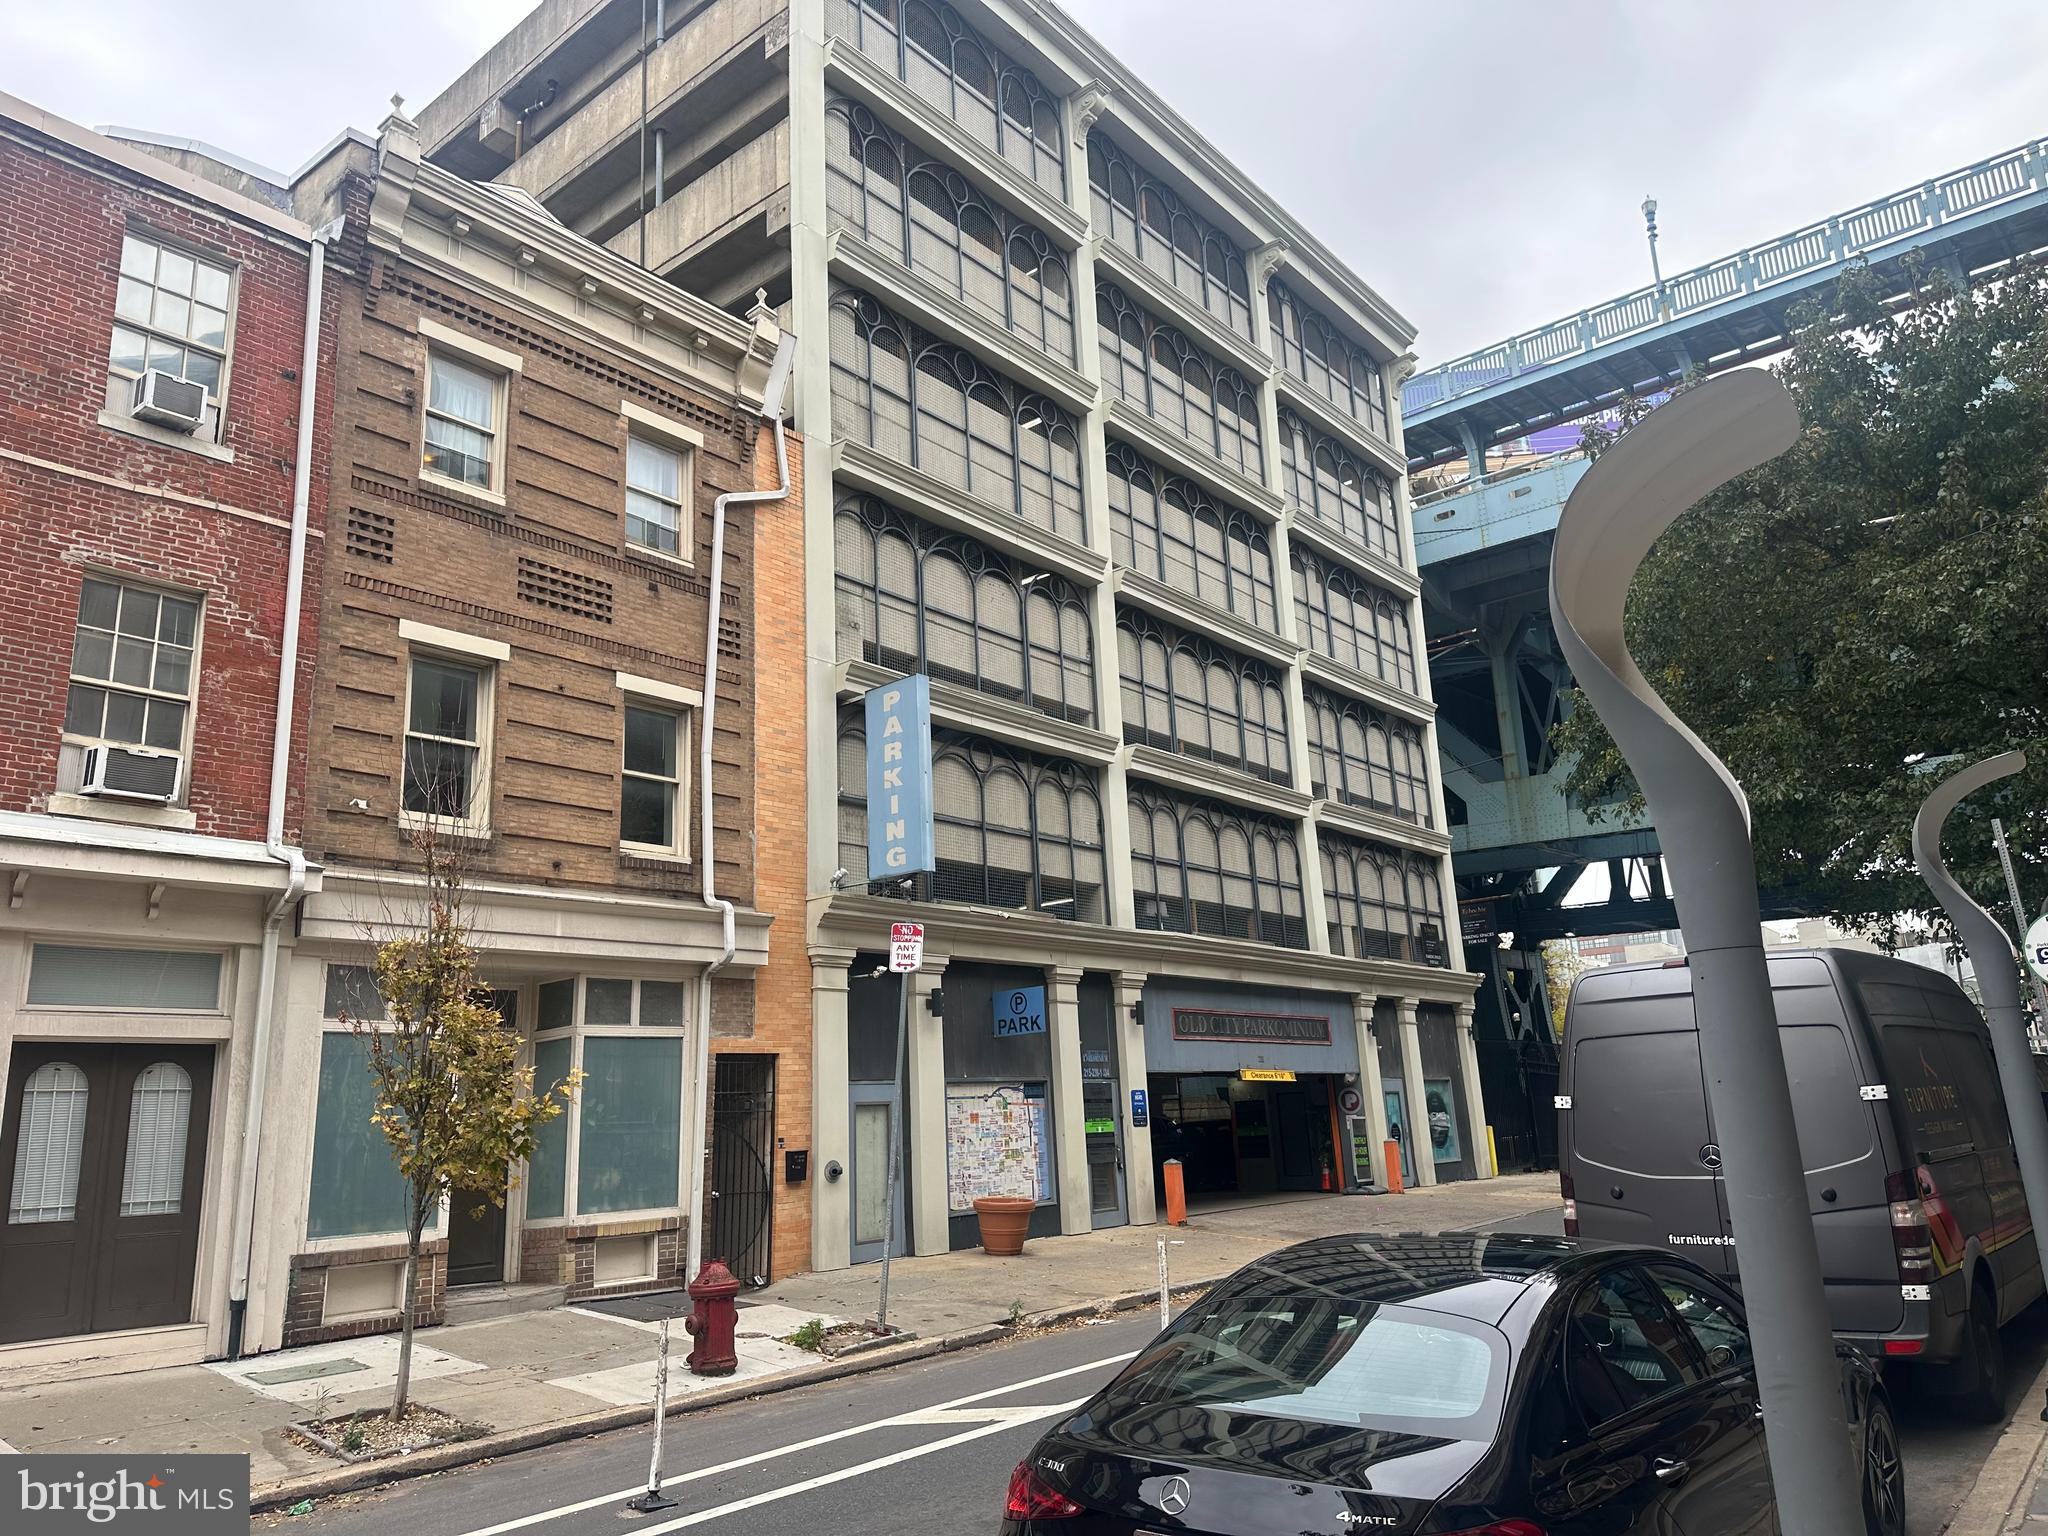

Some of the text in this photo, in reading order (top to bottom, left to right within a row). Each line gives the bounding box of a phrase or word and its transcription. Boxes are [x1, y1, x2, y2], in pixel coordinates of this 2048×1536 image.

[883, 690, 906, 867] PARKING
[901, 925, 914, 935] NO
[896, 944, 916, 952] ANY
[896, 953, 916, 961] TIME
[997, 1015, 1041, 1035] PARK
[1178, 1015, 1206, 1033] OLD
[1210, 1016, 1241, 1035] CITY
[1250, 1071, 1274, 1080] Clearance
[1904, 1086, 1959, 1113] FURNITURE
[1336, 1511, 1397, 1526] 4MATIC
